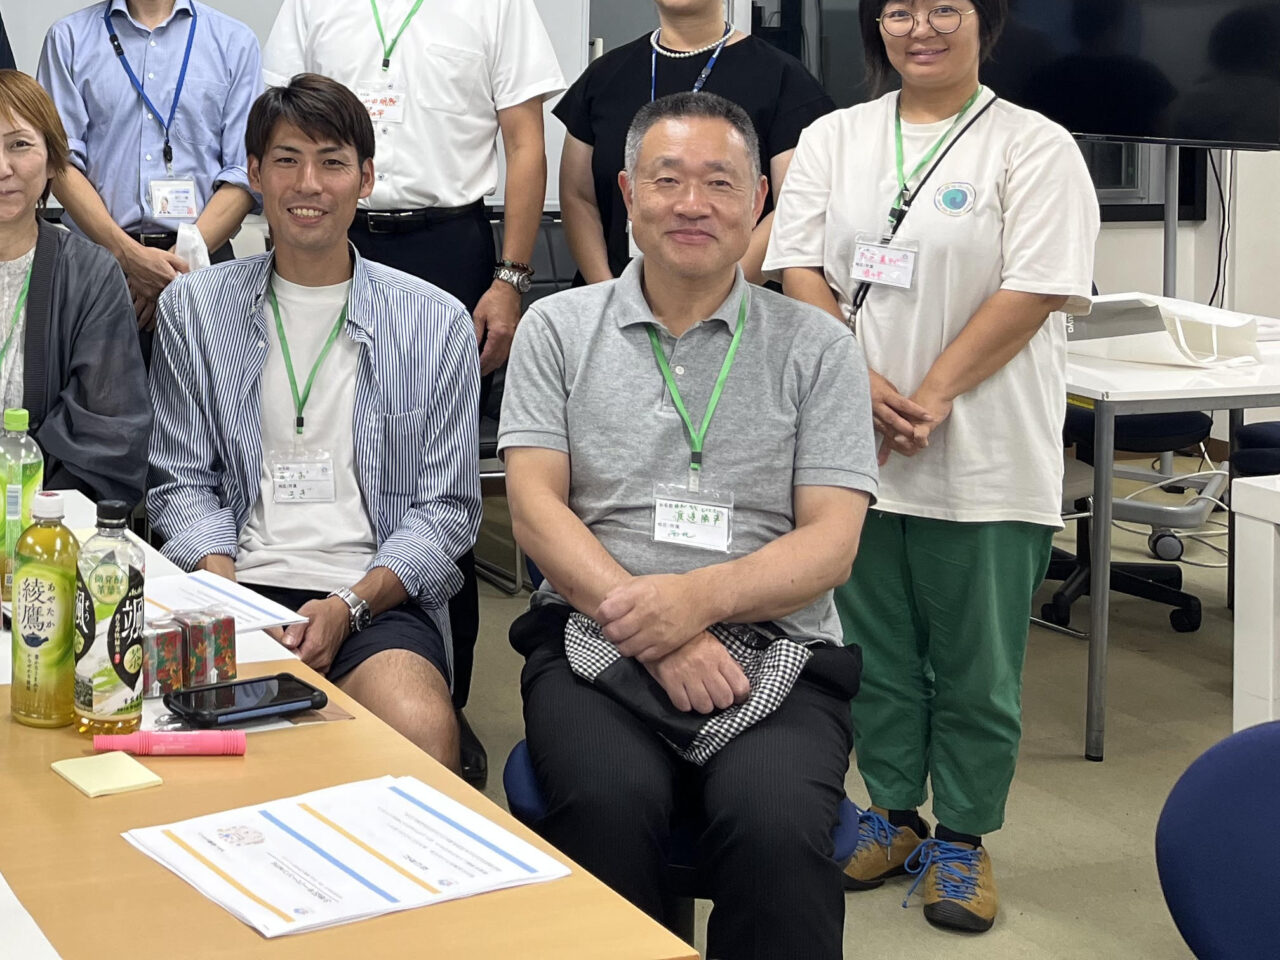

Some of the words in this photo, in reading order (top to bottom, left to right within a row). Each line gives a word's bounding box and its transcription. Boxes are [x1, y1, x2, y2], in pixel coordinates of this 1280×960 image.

[22, 577, 46, 633] 綾鷹
[46, 582, 56, 629] あやたか
